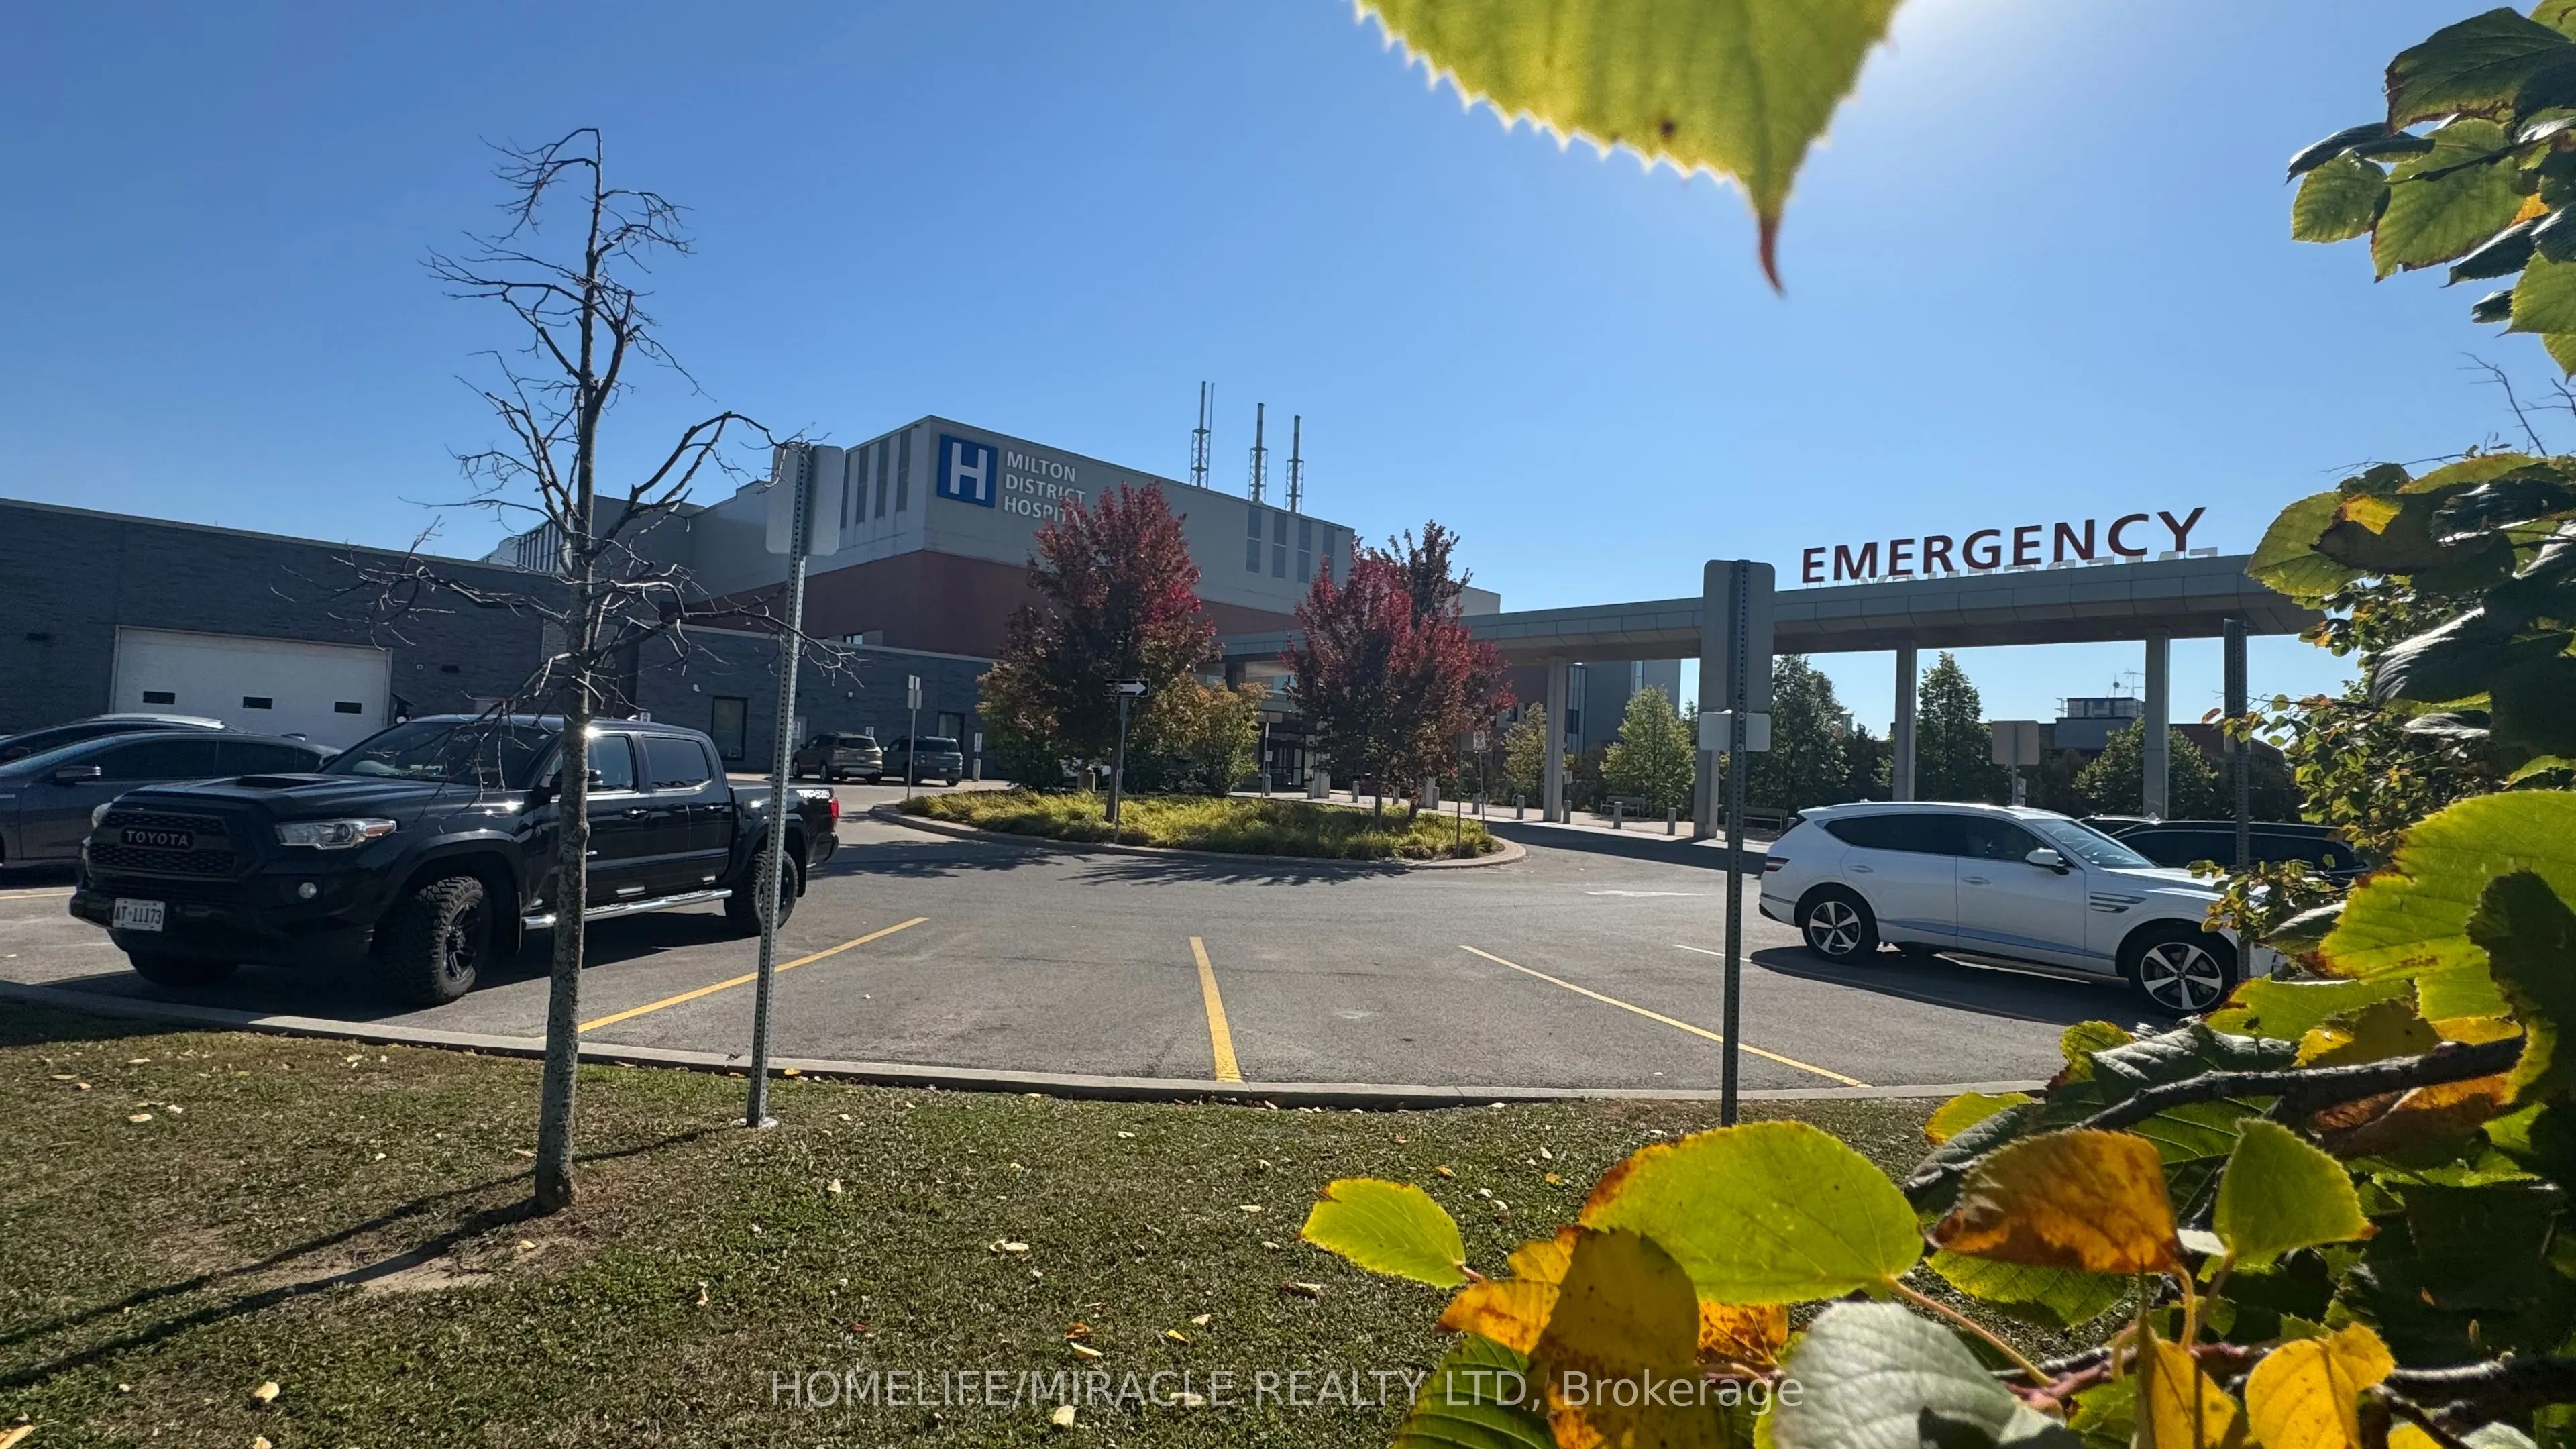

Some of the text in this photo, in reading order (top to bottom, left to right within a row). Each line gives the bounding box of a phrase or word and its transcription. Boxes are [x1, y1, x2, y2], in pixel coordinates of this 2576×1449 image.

[949, 441, 988, 501] H
[1007, 451, 1076, 482] MILTON
[1006, 474, 1086, 504] DISTRICT
[1801, 506, 2207, 584] EMERGENCY
[125, 830, 189, 846] TOYOTA
